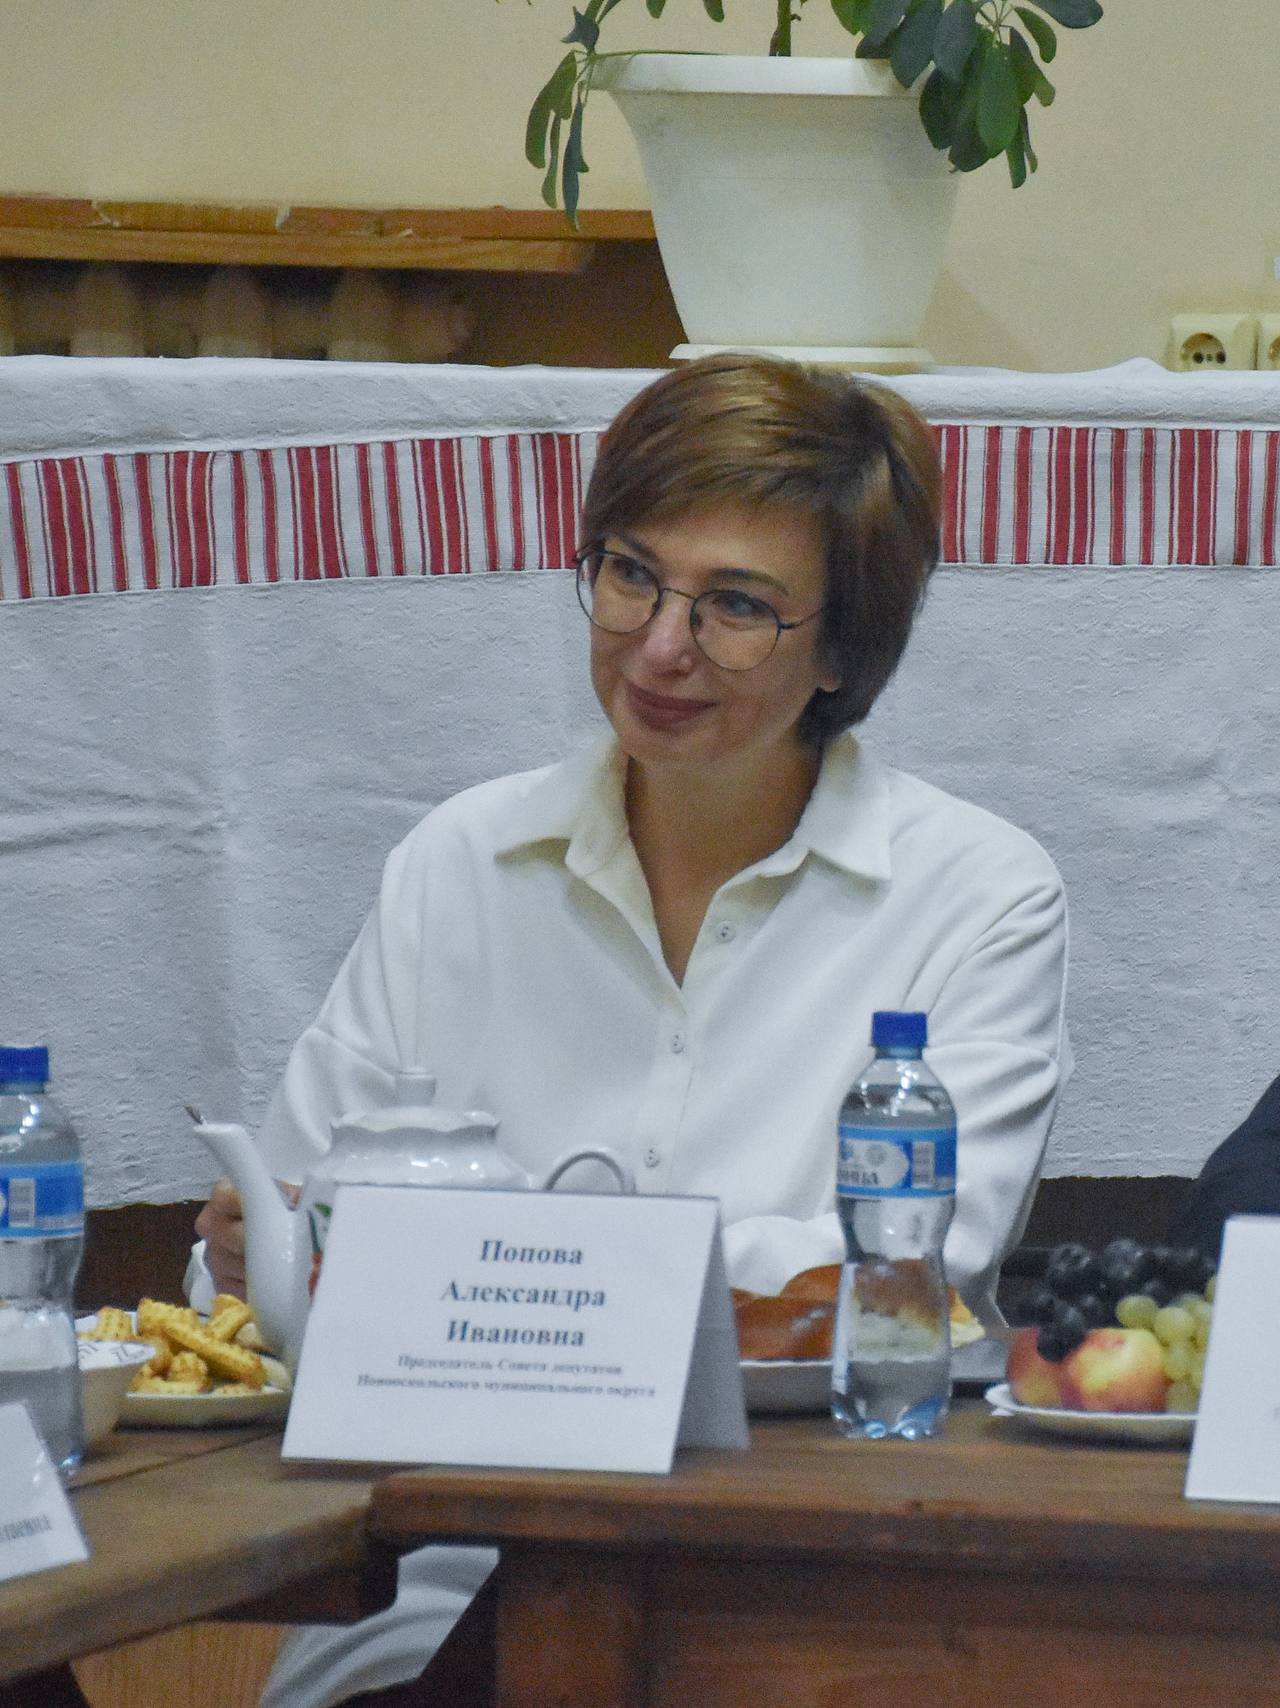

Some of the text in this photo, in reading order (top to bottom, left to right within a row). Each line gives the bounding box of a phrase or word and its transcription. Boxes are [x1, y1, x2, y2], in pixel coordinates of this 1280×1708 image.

[479, 1238, 583, 1266] Попова
[441, 1281, 606, 1313] Александра
[446, 1320, 585, 1347] Ивановна
